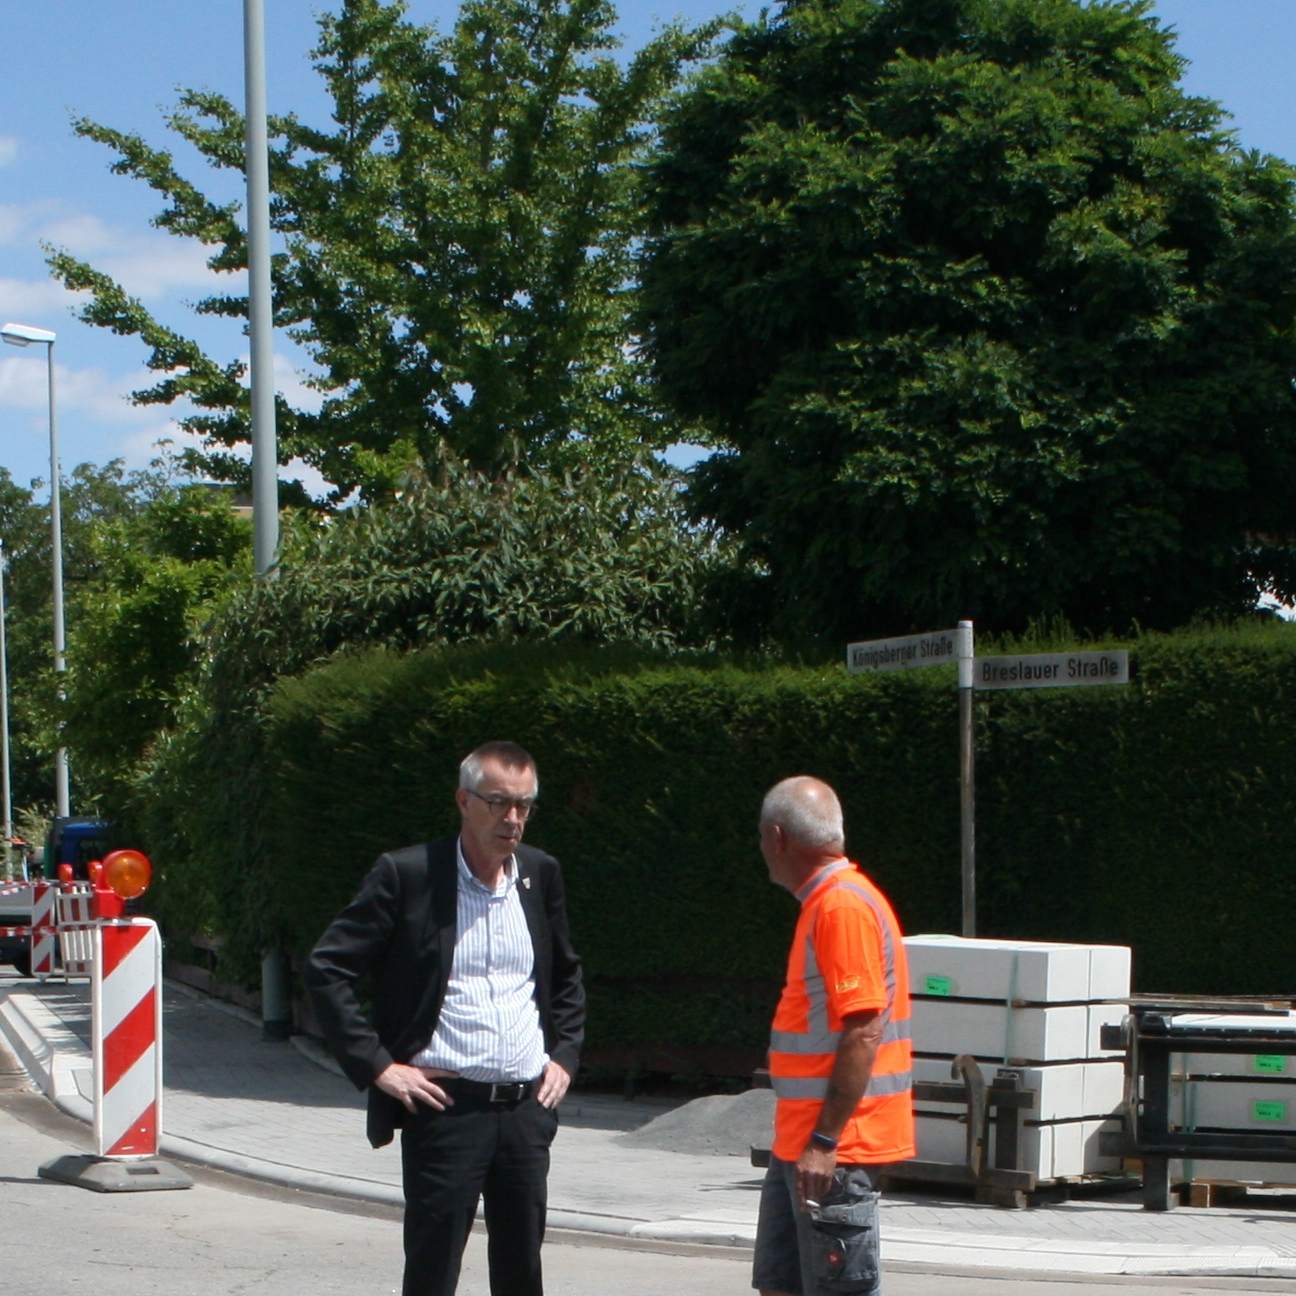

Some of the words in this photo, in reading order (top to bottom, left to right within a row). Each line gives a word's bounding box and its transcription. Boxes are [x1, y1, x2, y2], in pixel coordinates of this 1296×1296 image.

[852, 643, 917, 669] Königsberger
[920, 637, 954, 658] Straße
[982, 660, 1060, 682] Breslauer
[1067, 657, 1119, 678] Straße
